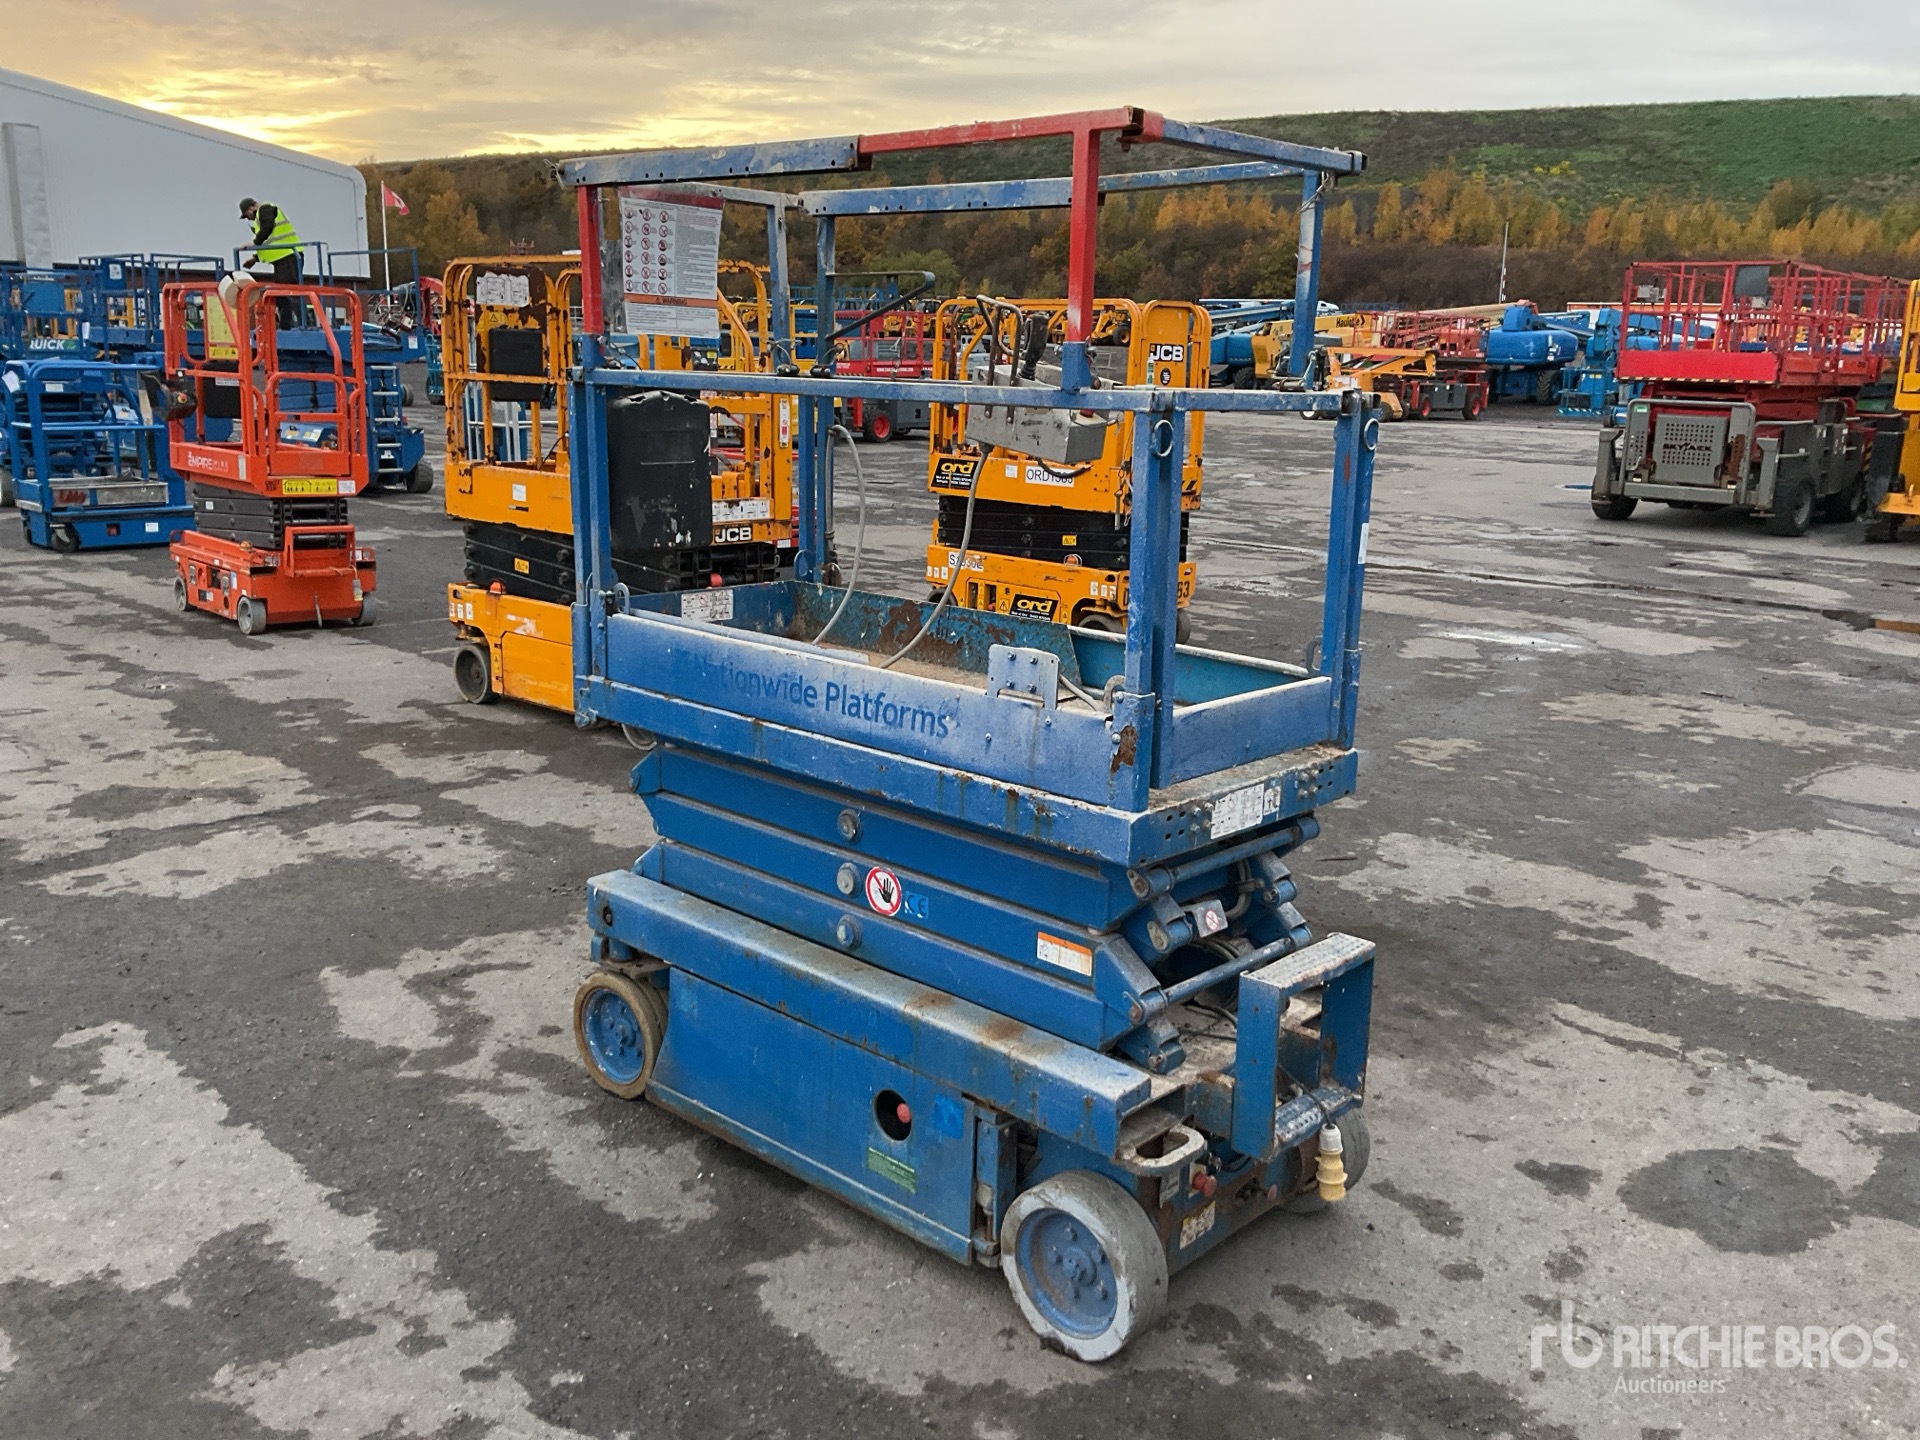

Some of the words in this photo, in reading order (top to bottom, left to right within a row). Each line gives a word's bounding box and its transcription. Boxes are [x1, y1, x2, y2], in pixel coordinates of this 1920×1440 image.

[1150, 345, 1184, 361] JCB
[941, 462, 975, 474] ord
[715, 528, 752, 543] JCB
[1017, 599, 1053, 613] ord
[825, 682, 949, 738] Platforms
